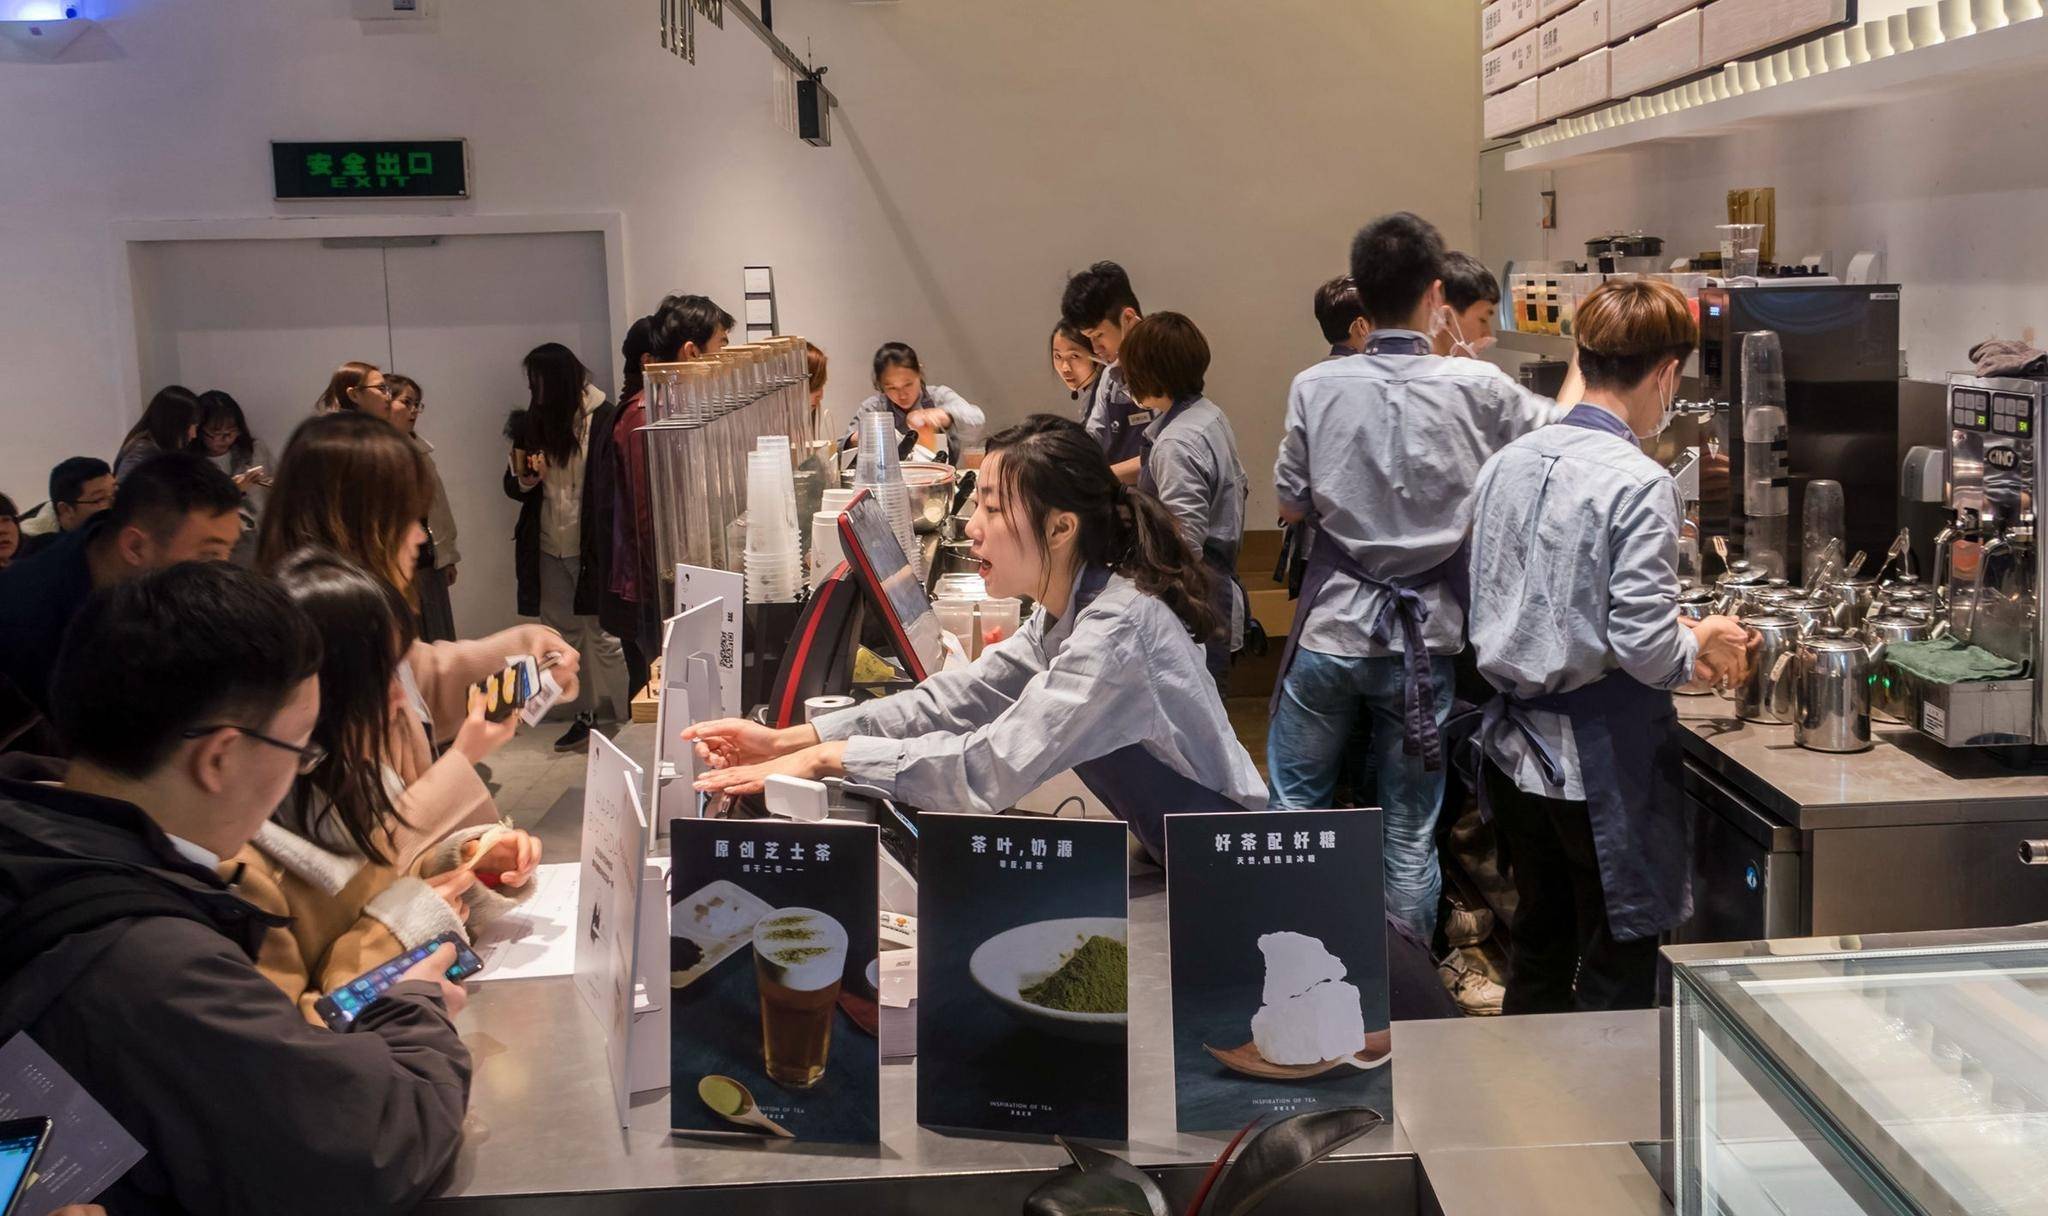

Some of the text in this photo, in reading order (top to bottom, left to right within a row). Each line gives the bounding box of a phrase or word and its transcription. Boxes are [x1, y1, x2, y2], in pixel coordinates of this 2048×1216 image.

[306, 152, 433, 175] 安全出口
[330, 176, 412, 188] EXIT
[715, 839, 831, 862] 原创芝士茶
[1215, 830, 1336, 852] 好茶配好糖
